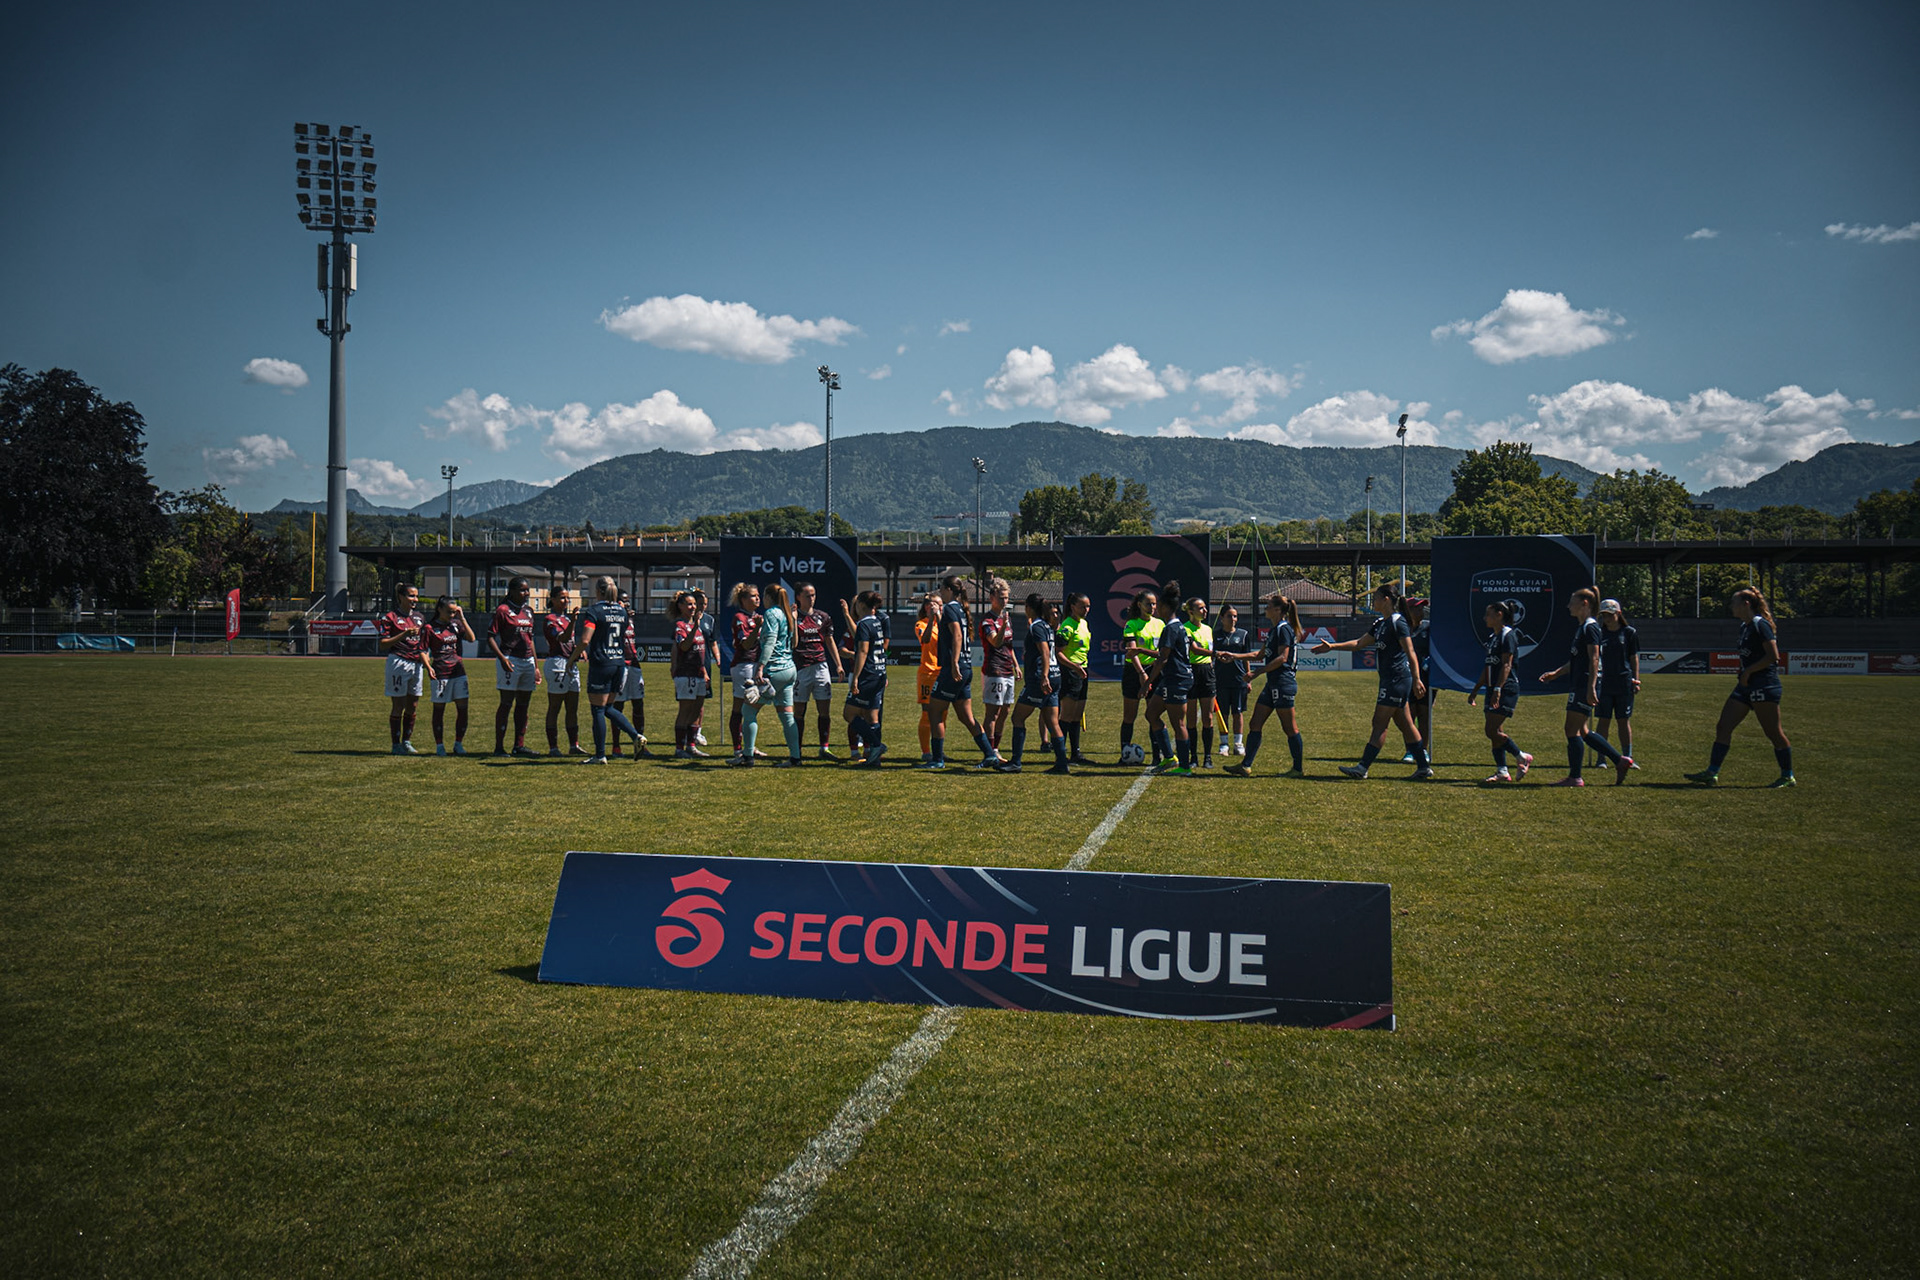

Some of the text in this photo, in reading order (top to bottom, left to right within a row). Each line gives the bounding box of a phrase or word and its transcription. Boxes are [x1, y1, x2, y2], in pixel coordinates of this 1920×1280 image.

[751, 556, 827, 573] Fc Metz
[607, 623, 620, 648] 2
[1297, 655, 1337, 669] essager
[392, 675, 403, 687] 14
[688, 677, 697, 688] 13
[921, 685, 931, 697] 16
[991, 682, 1003, 694] 20
[1749, 689, 1765, 702] 25
[749, 910, 1267, 986] SECONDE LIGUE
